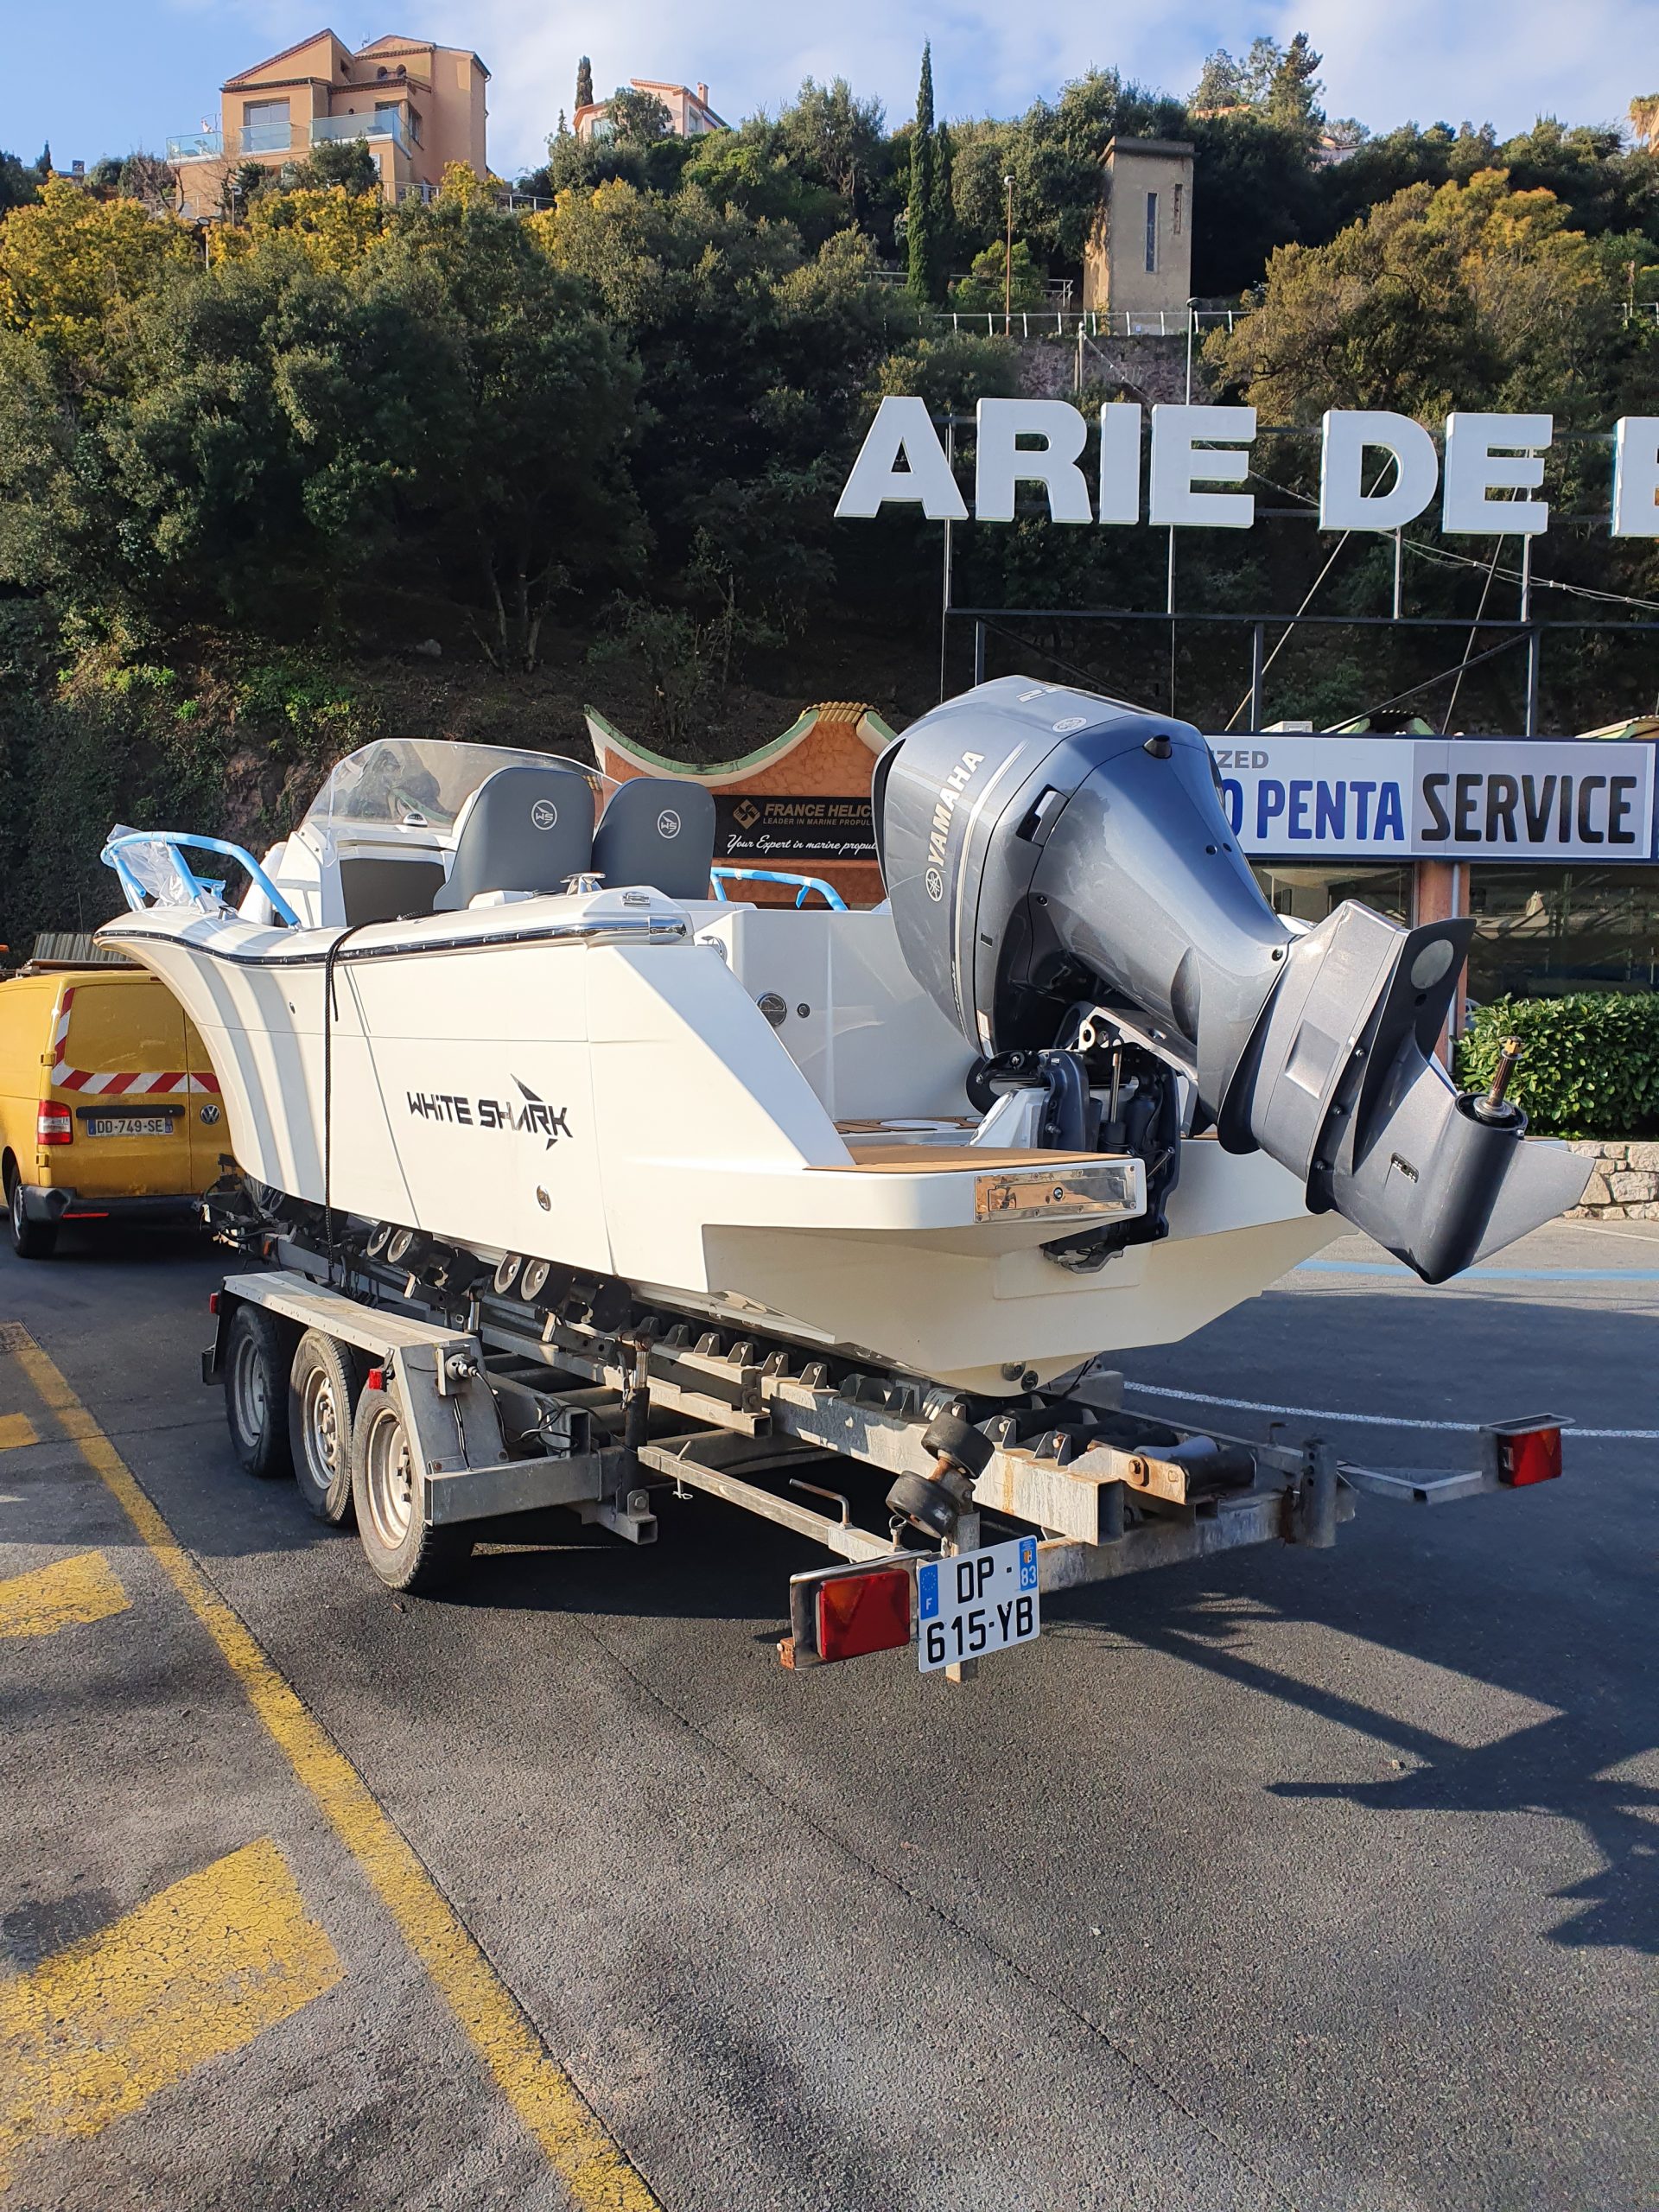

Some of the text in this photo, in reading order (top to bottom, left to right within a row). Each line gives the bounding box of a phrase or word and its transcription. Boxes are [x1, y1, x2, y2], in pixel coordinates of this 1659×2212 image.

[834, 396, 1257, 526] ARIE
[1319, 409, 1554, 535] DE
[1211, 750, 1269, 769] ZED
[764, 803, 873, 818] FRANCE HELIC
[927, 750, 985, 867] YAMAHA
[1256, 779, 1405, 841] PENTA
[1421, 772, 1637, 844] SERVICE
[727, 834, 754, 855] Your
[756, 834, 791, 854] Expert
[793, 840, 804, 849] in
[805, 840, 841, 850] marine
[477, 1089, 574, 1141] SHARK
[97, 1119, 163, 1134] DD-749-SE
[1020, 1565, 1037, 1586] 83
[925, 1597, 933, 1611] F
[926, 1595, 1033, 1664] 615-YB
